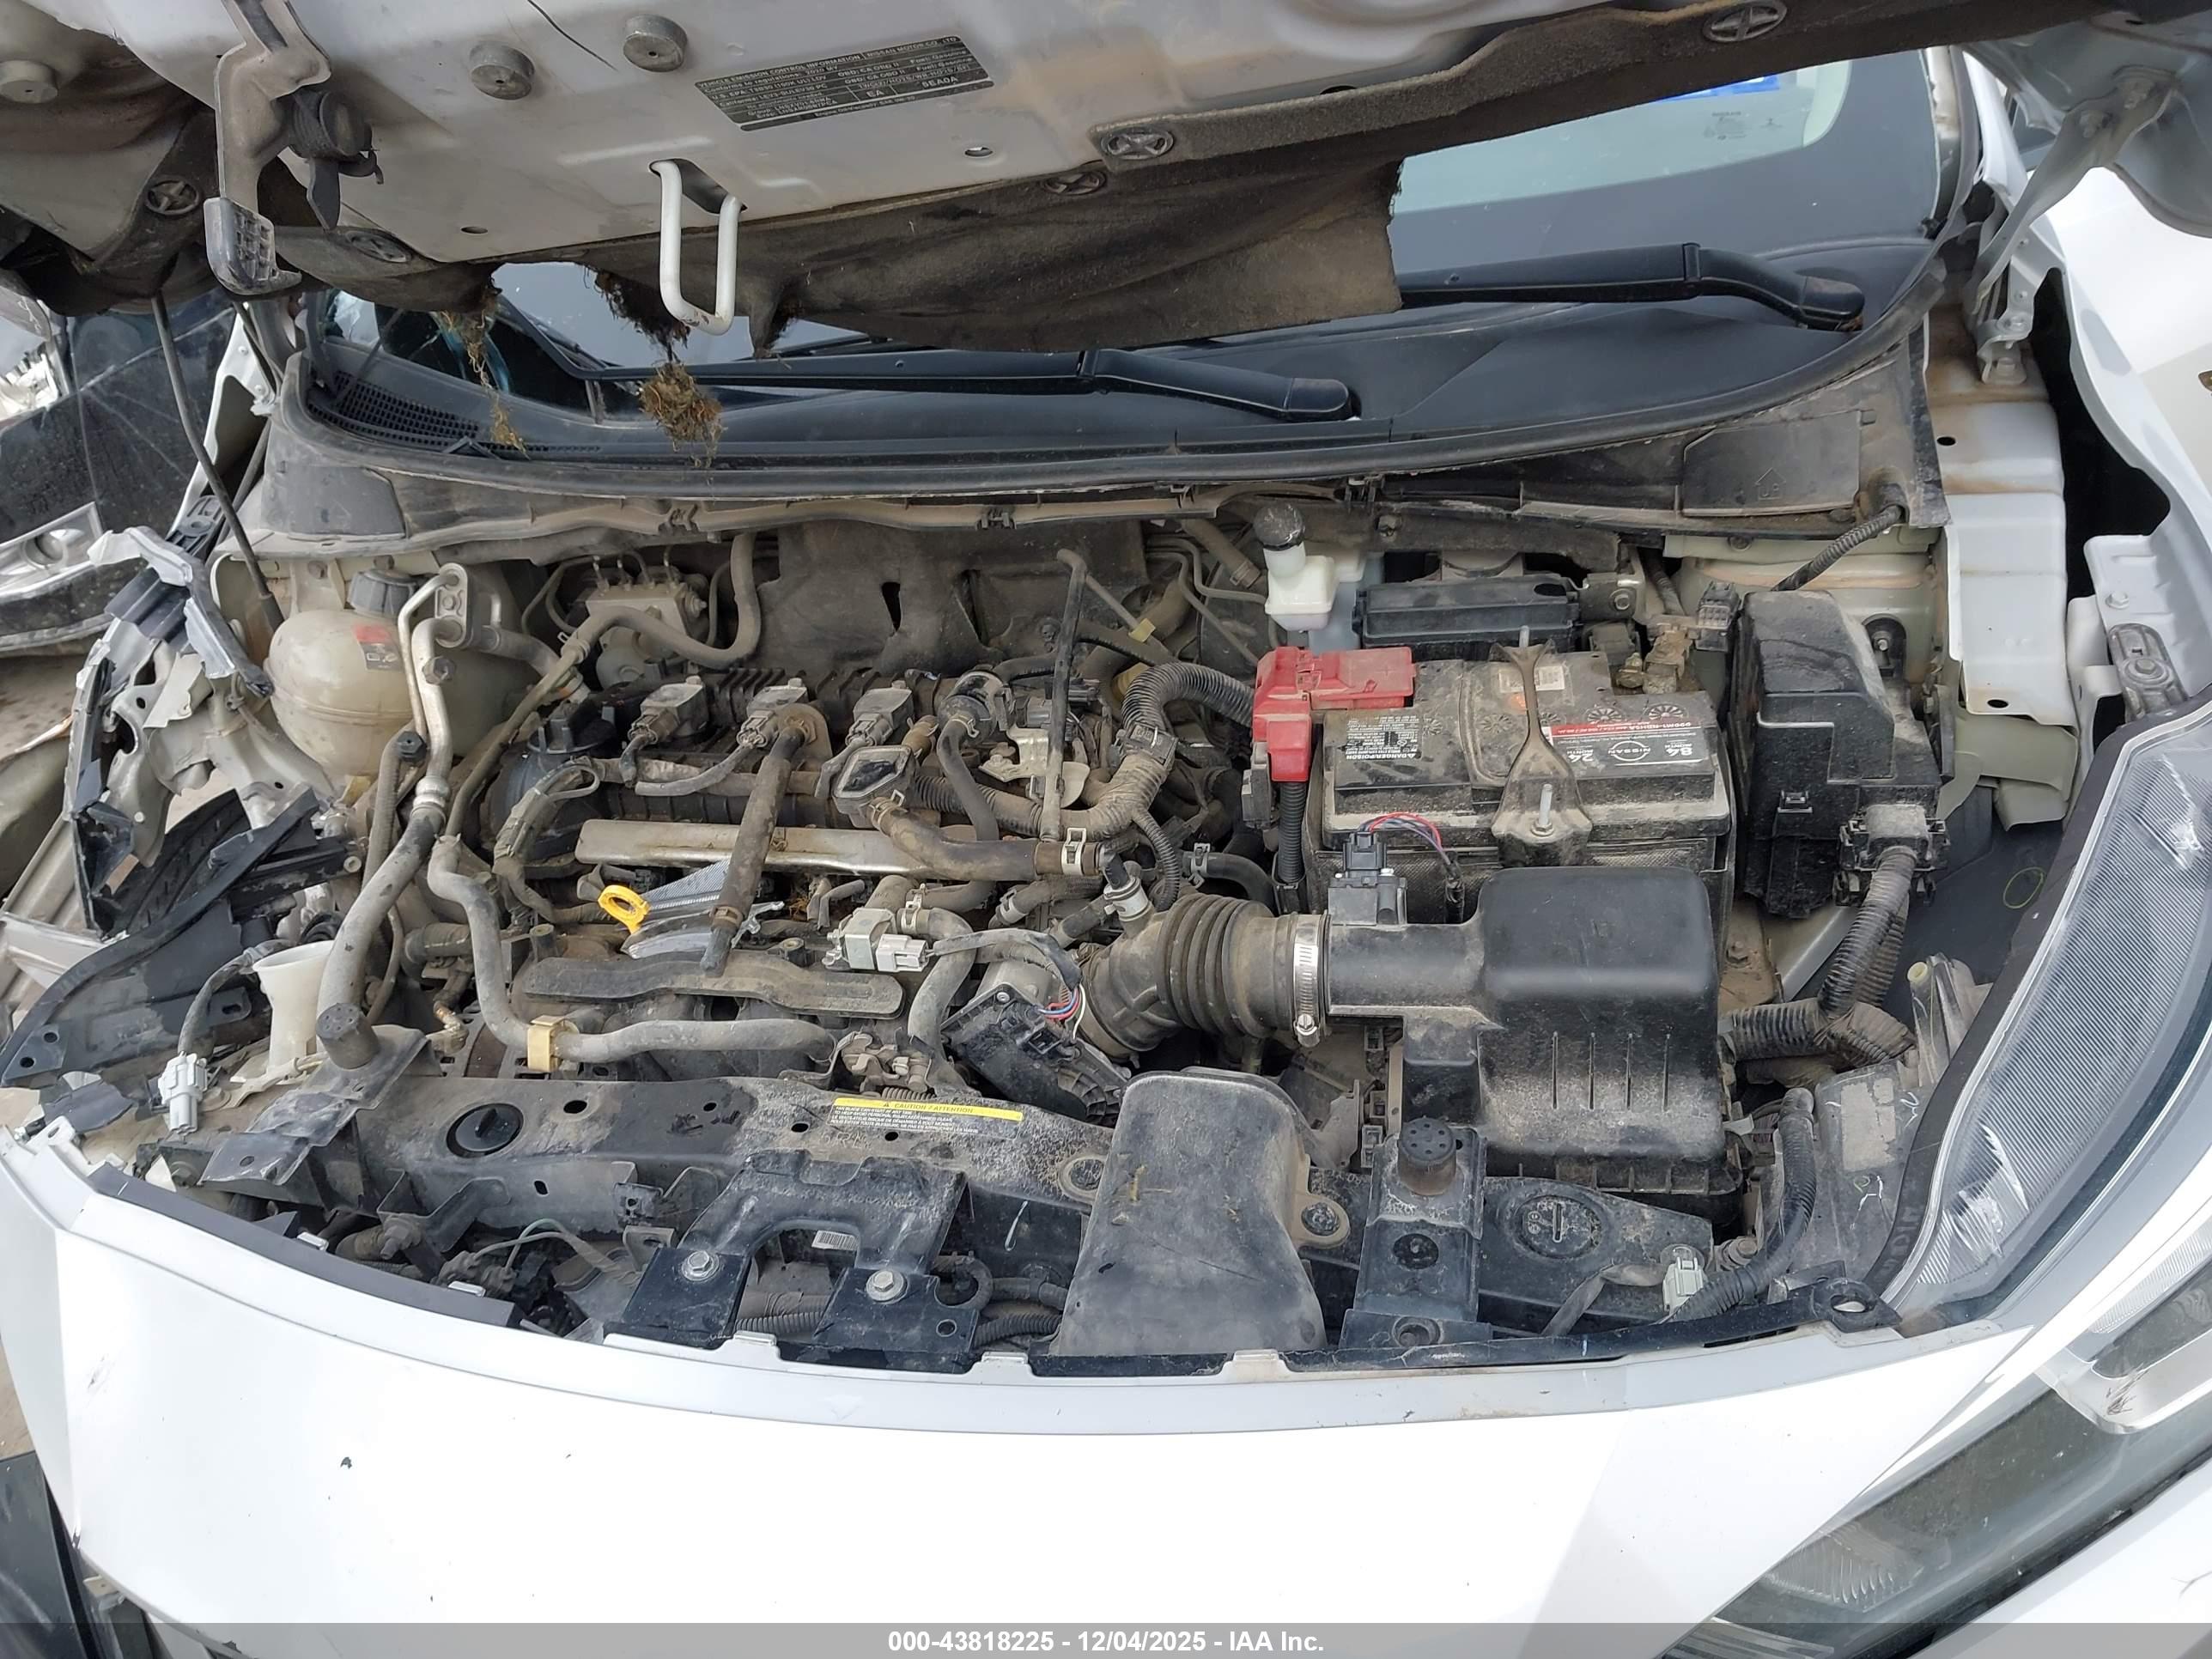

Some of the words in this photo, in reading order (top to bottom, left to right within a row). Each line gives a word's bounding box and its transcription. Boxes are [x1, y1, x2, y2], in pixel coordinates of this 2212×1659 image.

[866, 47, 896, 57] NISSAN
[897, 43, 925, 53] MOTOR
[731, 70, 769, 82] EMISSION
[769, 65, 805, 76] CONTROL
[807, 54, 860, 69] INFORMATION
[1666, 747, 1692, 757] 84
[1568, 754, 1594, 763] 24
[895, 1103, 926, 1111] CAUTION
[934, 1105, 974, 1114] ATTENTION
